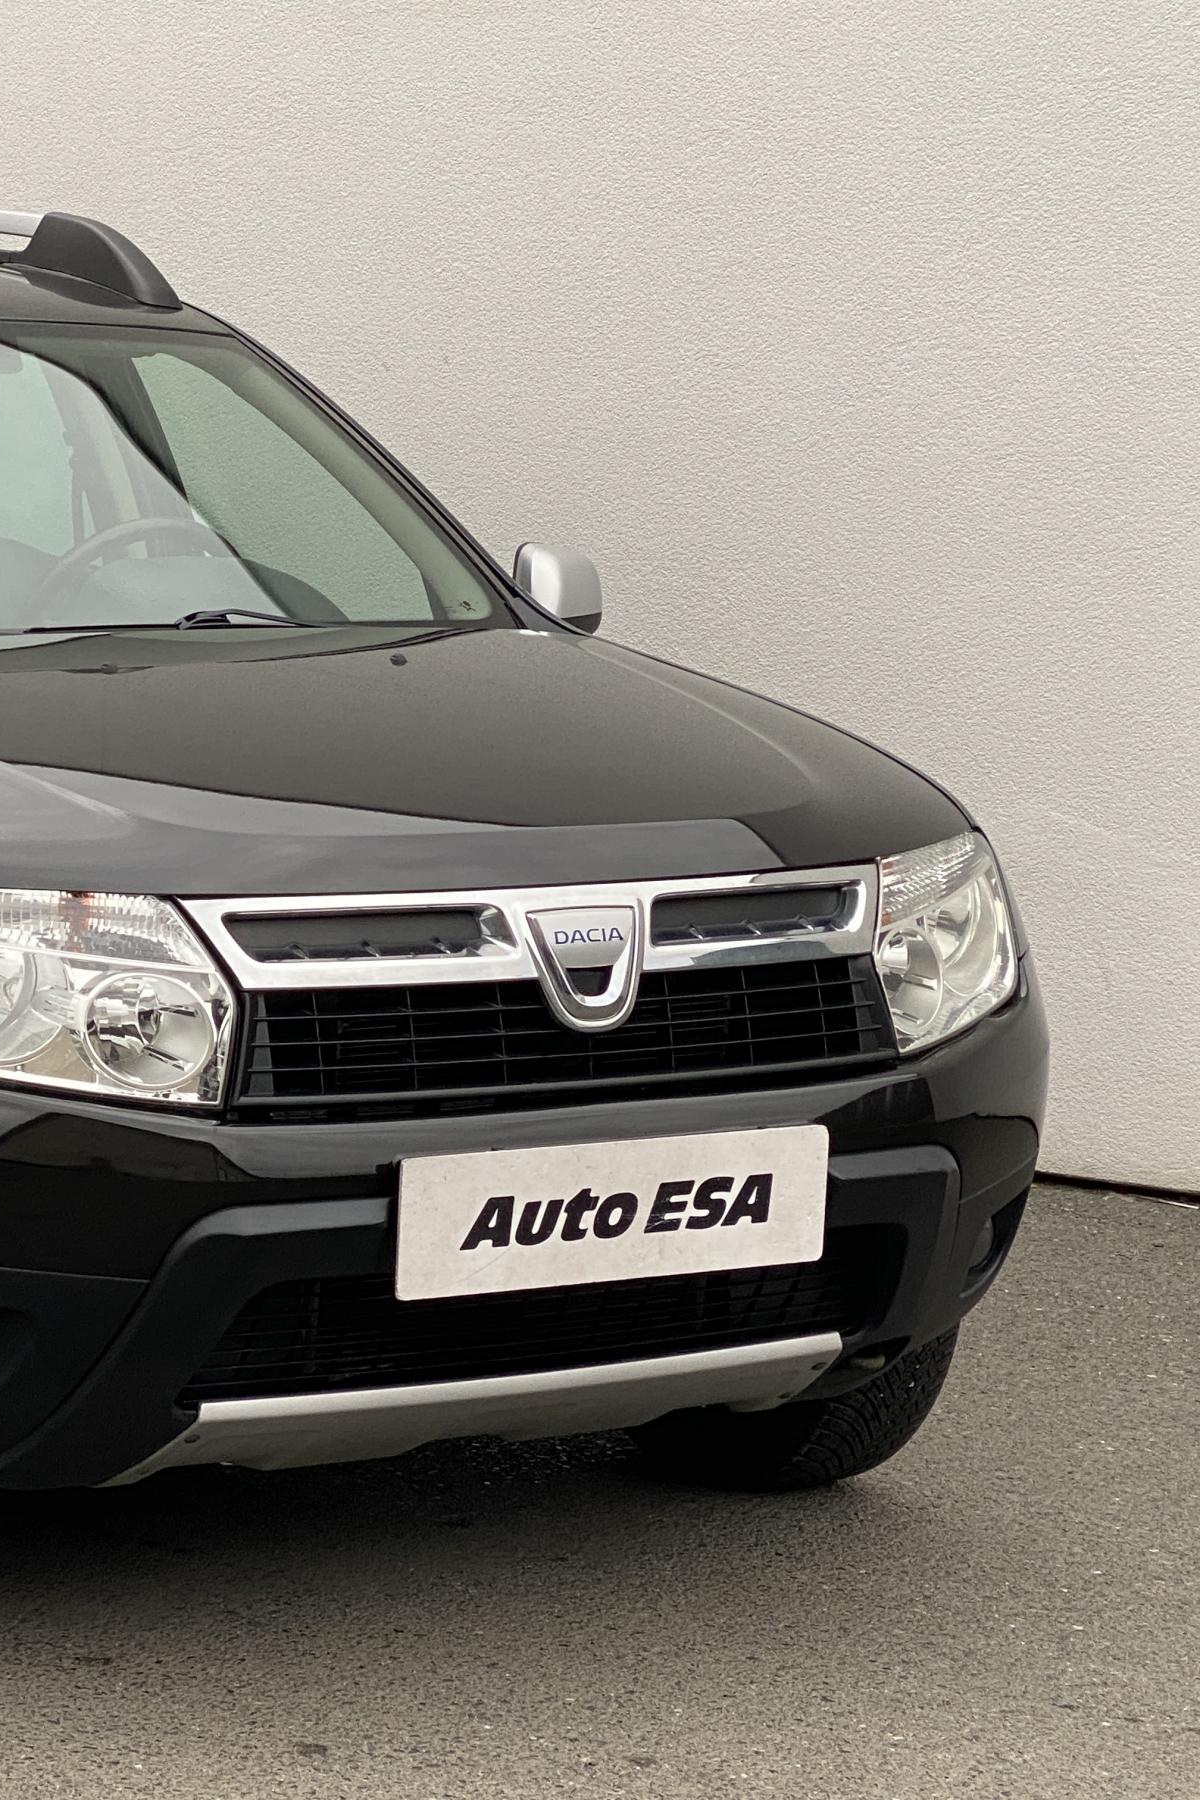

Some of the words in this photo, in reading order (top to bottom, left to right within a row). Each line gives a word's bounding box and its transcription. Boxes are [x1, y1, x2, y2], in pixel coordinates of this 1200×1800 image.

[554, 927, 624, 945] DACIA
[459, 1187, 639, 1251] Auto
[643, 1173, 773, 1234] ESA
